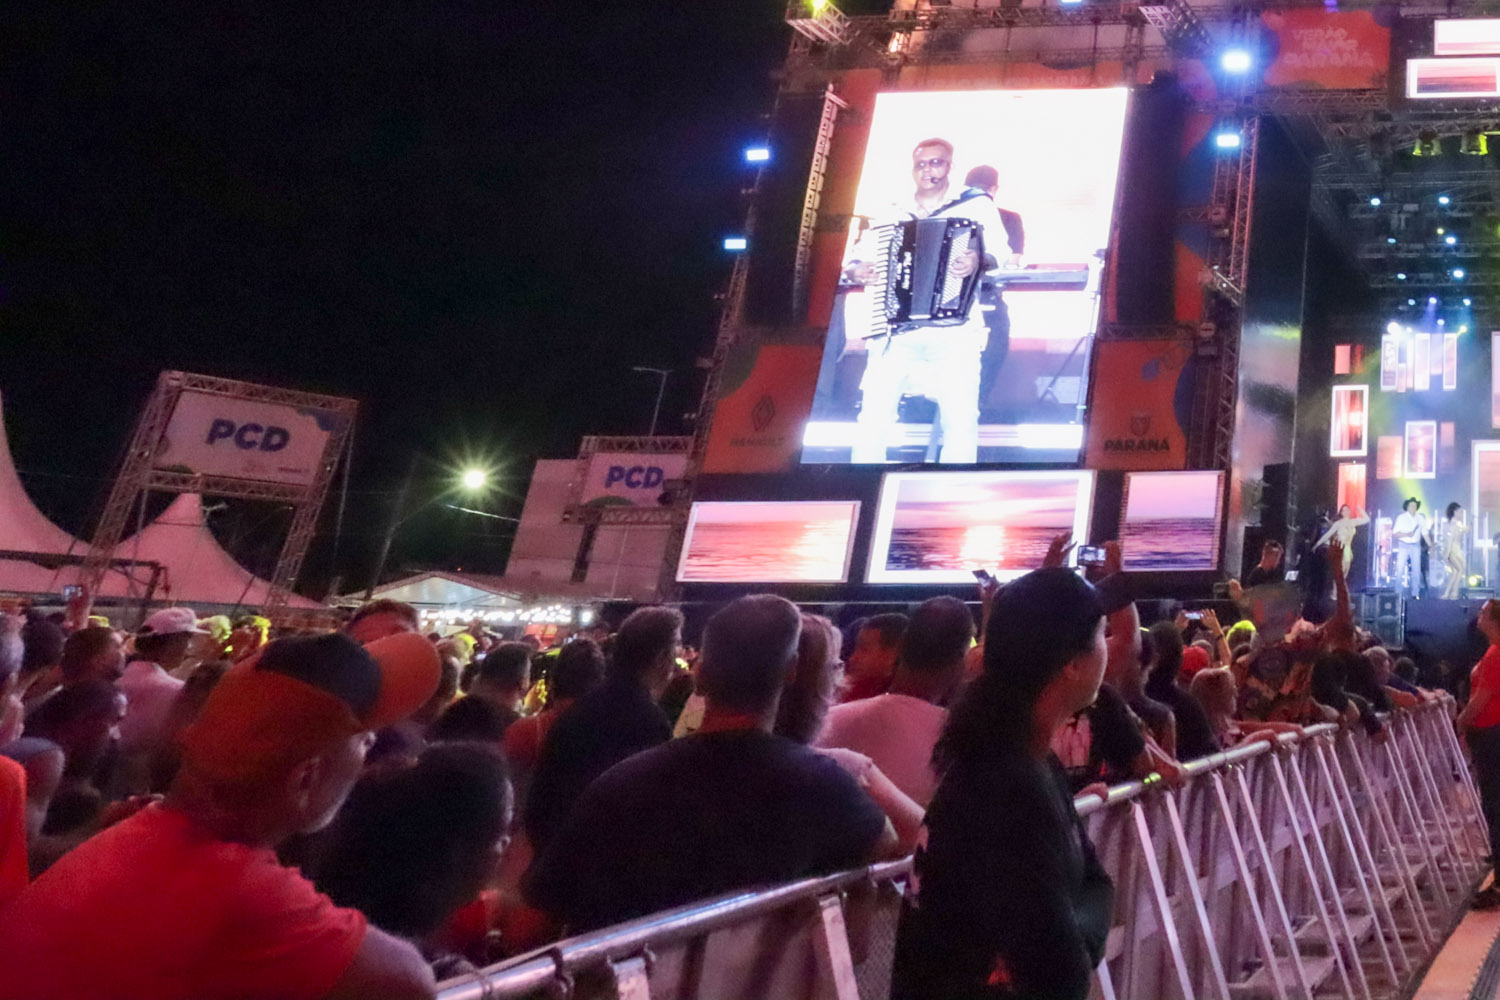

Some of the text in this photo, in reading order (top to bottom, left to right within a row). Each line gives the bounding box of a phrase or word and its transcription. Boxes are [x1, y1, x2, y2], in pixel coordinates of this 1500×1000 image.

[205, 418, 290, 453] PCD
[1104, 436, 1170, 452] PARANÁ
[604, 465, 664, 489] PCD
